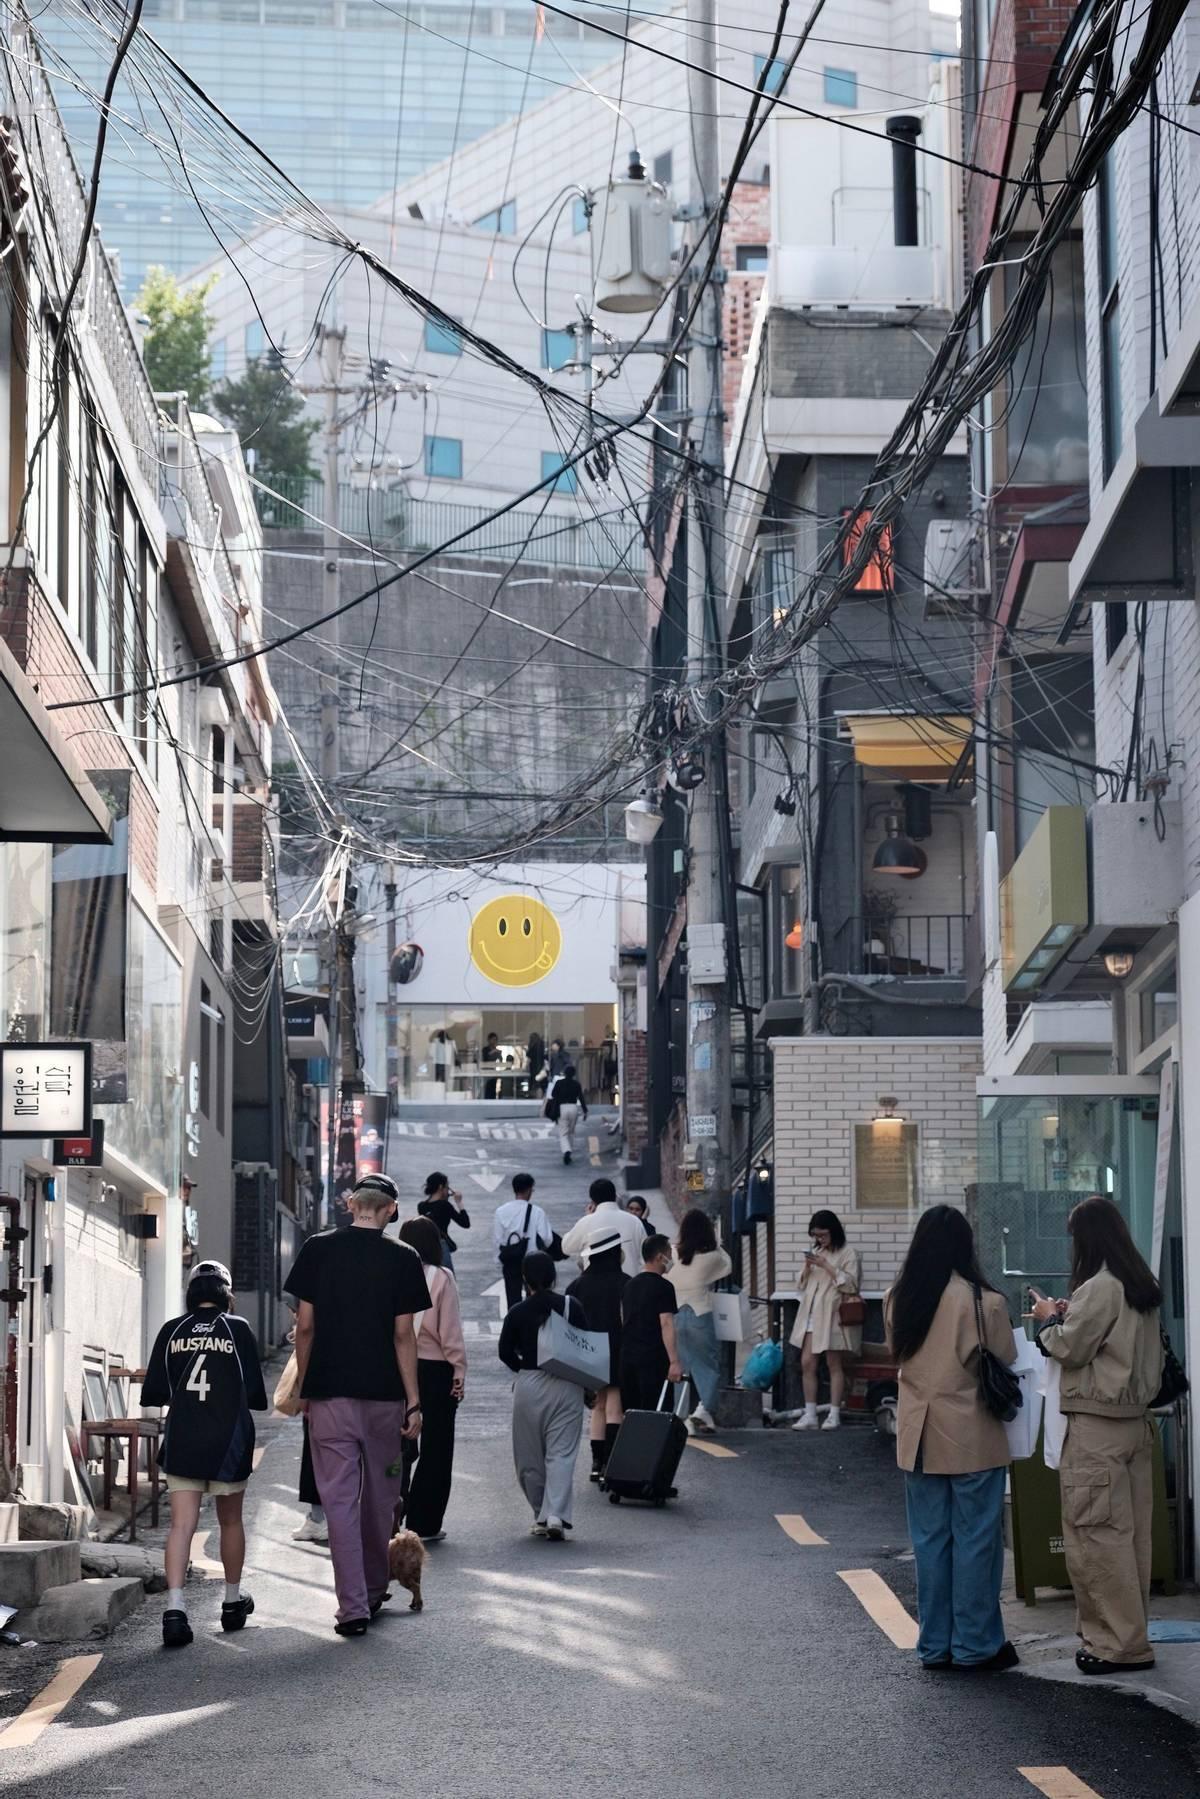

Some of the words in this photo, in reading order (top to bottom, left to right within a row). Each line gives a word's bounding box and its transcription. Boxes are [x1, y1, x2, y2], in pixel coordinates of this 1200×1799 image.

[13, 1065, 40, 1116] 이원일
[45, 1065, 72, 1096] 식탁
[192, 1323, 216, 1333] Ford
[171, 1337, 234, 1354] MUSTANG
[186, 1353, 211, 1401] 4
